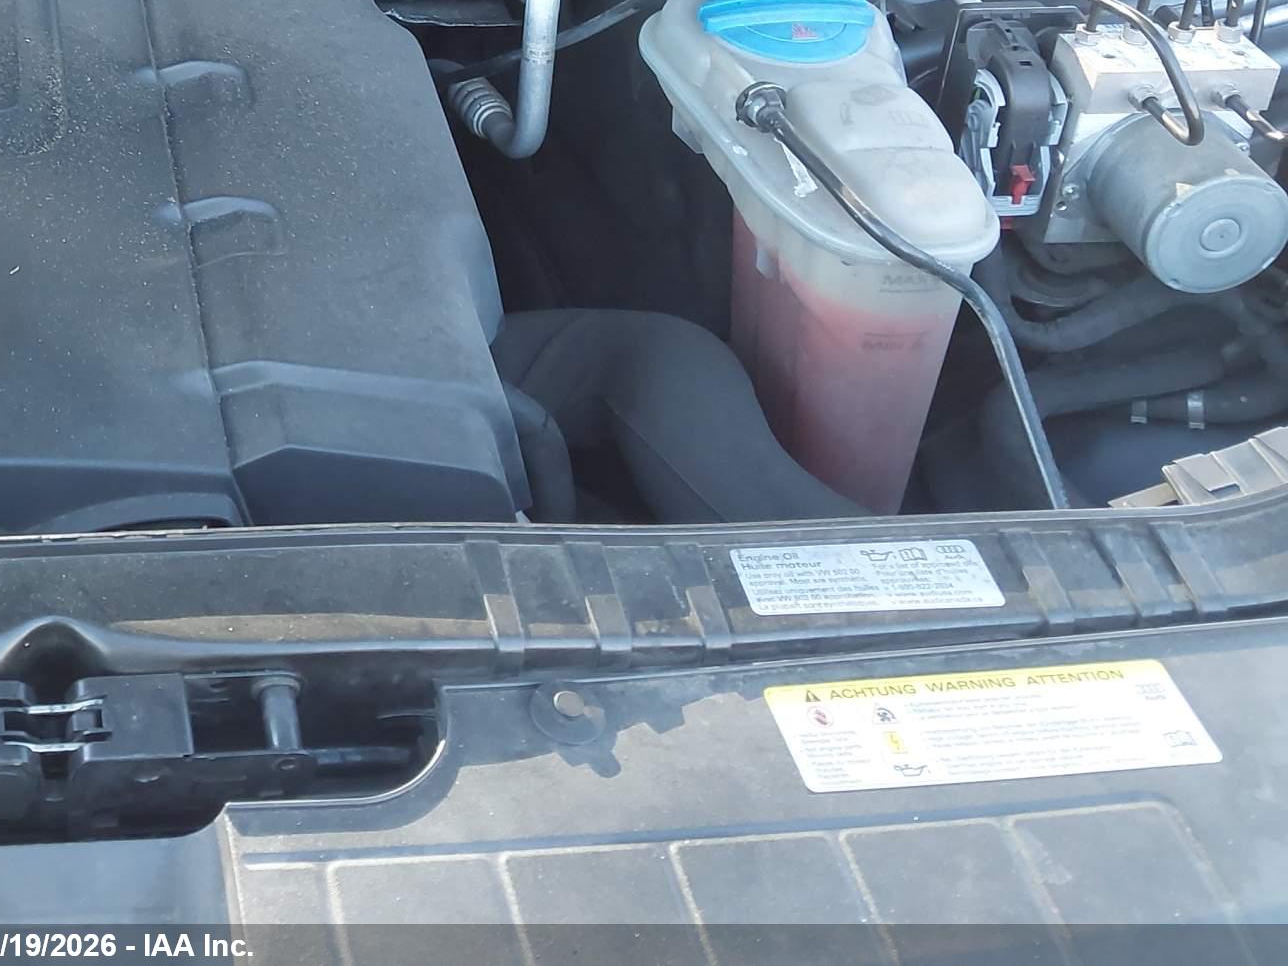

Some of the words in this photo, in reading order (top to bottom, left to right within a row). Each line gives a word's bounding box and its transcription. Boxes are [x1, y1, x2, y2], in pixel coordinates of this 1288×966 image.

[738, 554, 779, 563] Engine
[782, 552, 799, 560] Oil
[830, 684, 916, 700] ACHTUNG
[925, 677, 1016, 693] WARNING
[1027, 669, 1124, 686] ATTENTION
